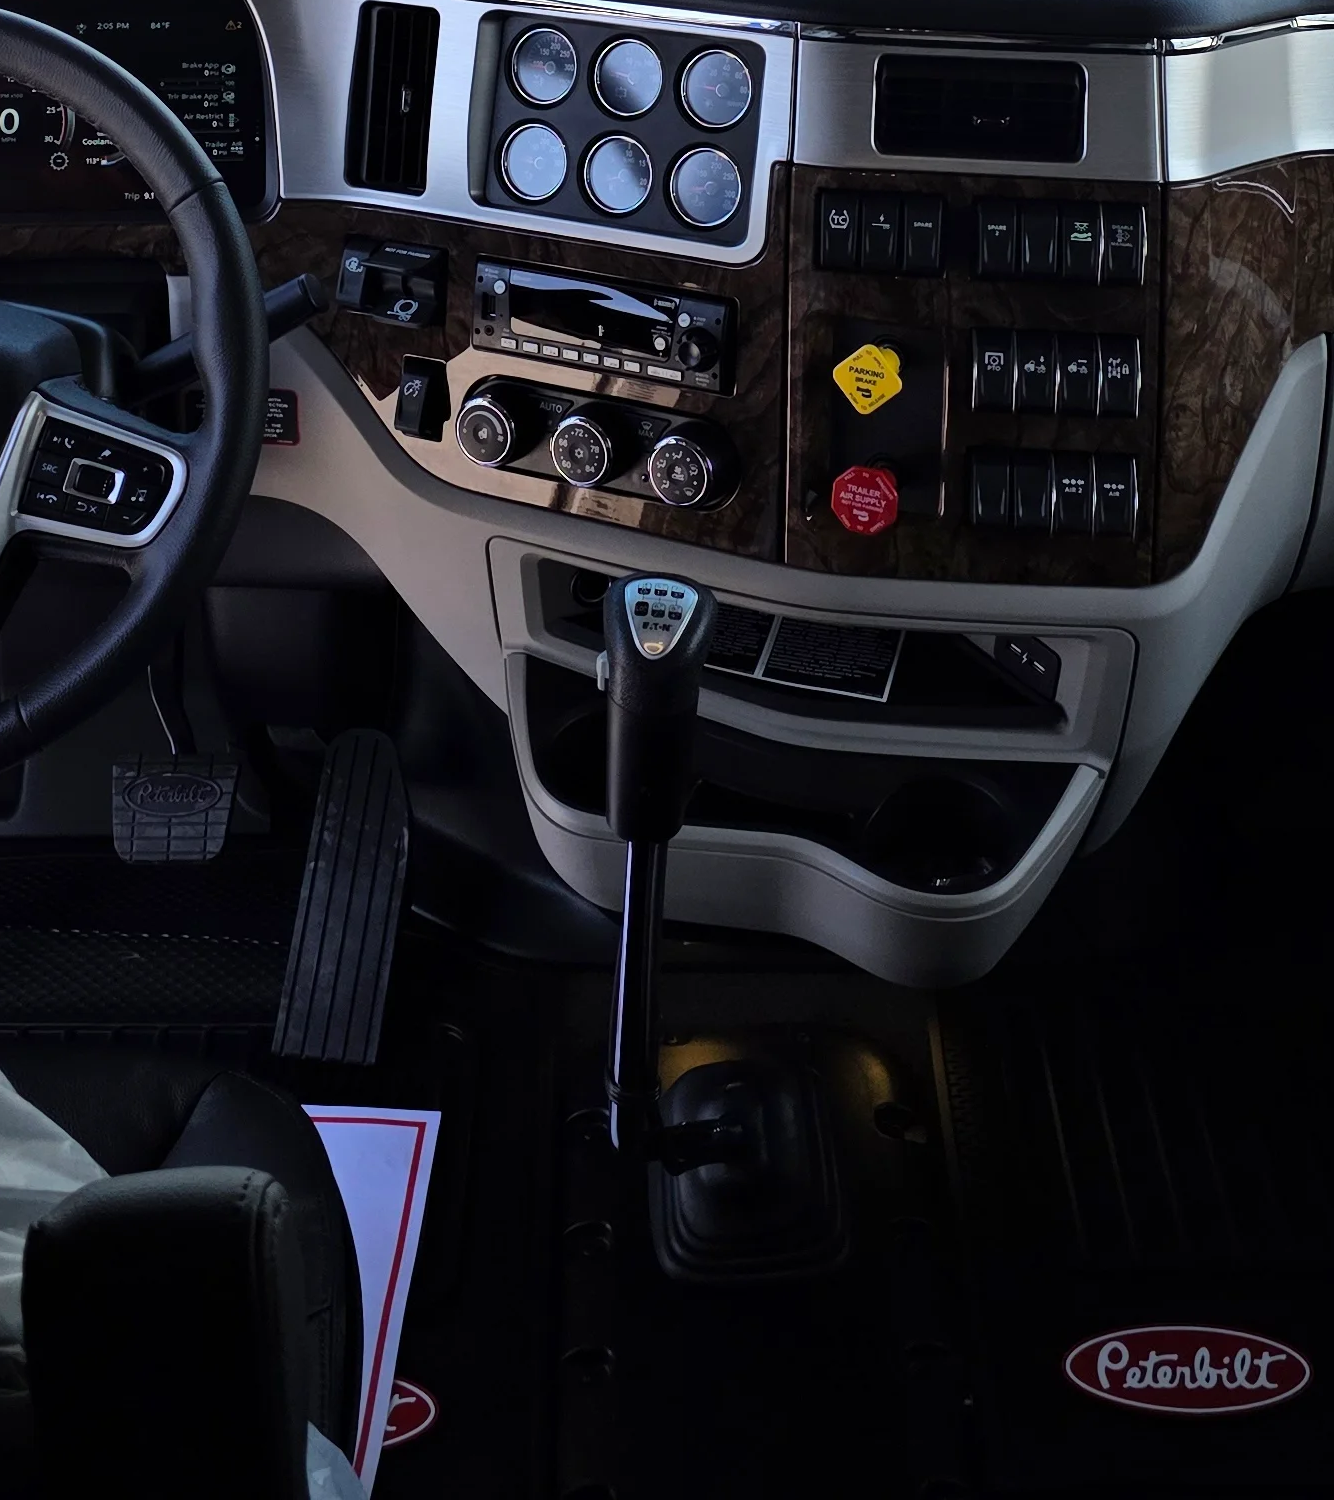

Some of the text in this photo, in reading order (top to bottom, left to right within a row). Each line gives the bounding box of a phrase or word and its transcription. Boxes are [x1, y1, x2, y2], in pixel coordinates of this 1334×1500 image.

[116, 22, 130, 31] PM
[550, 42, 561, 50] 200
[559, 50, 571, 58] 250
[181, 61, 220, 70] Brake App
[564, 63, 575, 71] 300
[204, 93, 219, 101] App
[46, 106, 56, 114] 25
[0, 107, 20, 135] 0
[196, 112, 224, 120] Restrict
[43, 135, 54, 143] 30
[82, 138, 115, 146] Coolan
[124, 191, 141, 201] Trip
[832, 215, 846, 225] TC
[848, 365, 885, 380] PARKING
[854, 376, 878, 386] BRAKE
[538, 401, 563, 414] AUTO
[574, 428, 584, 437] 72
[638, 428, 655, 439] MAX
[590, 444, 600, 454] 78
[41, 462, 58, 475] SRC
[561, 460, 572, 469] 60
[584, 464, 596, 474] 84
[846, 483, 881, 498] TRAILER
[839, 490, 887, 508] AIR SUPPLY
[137, 781, 212, 805] Peterbilt
[1096, 1340, 1287, 1390] Peterbilt
